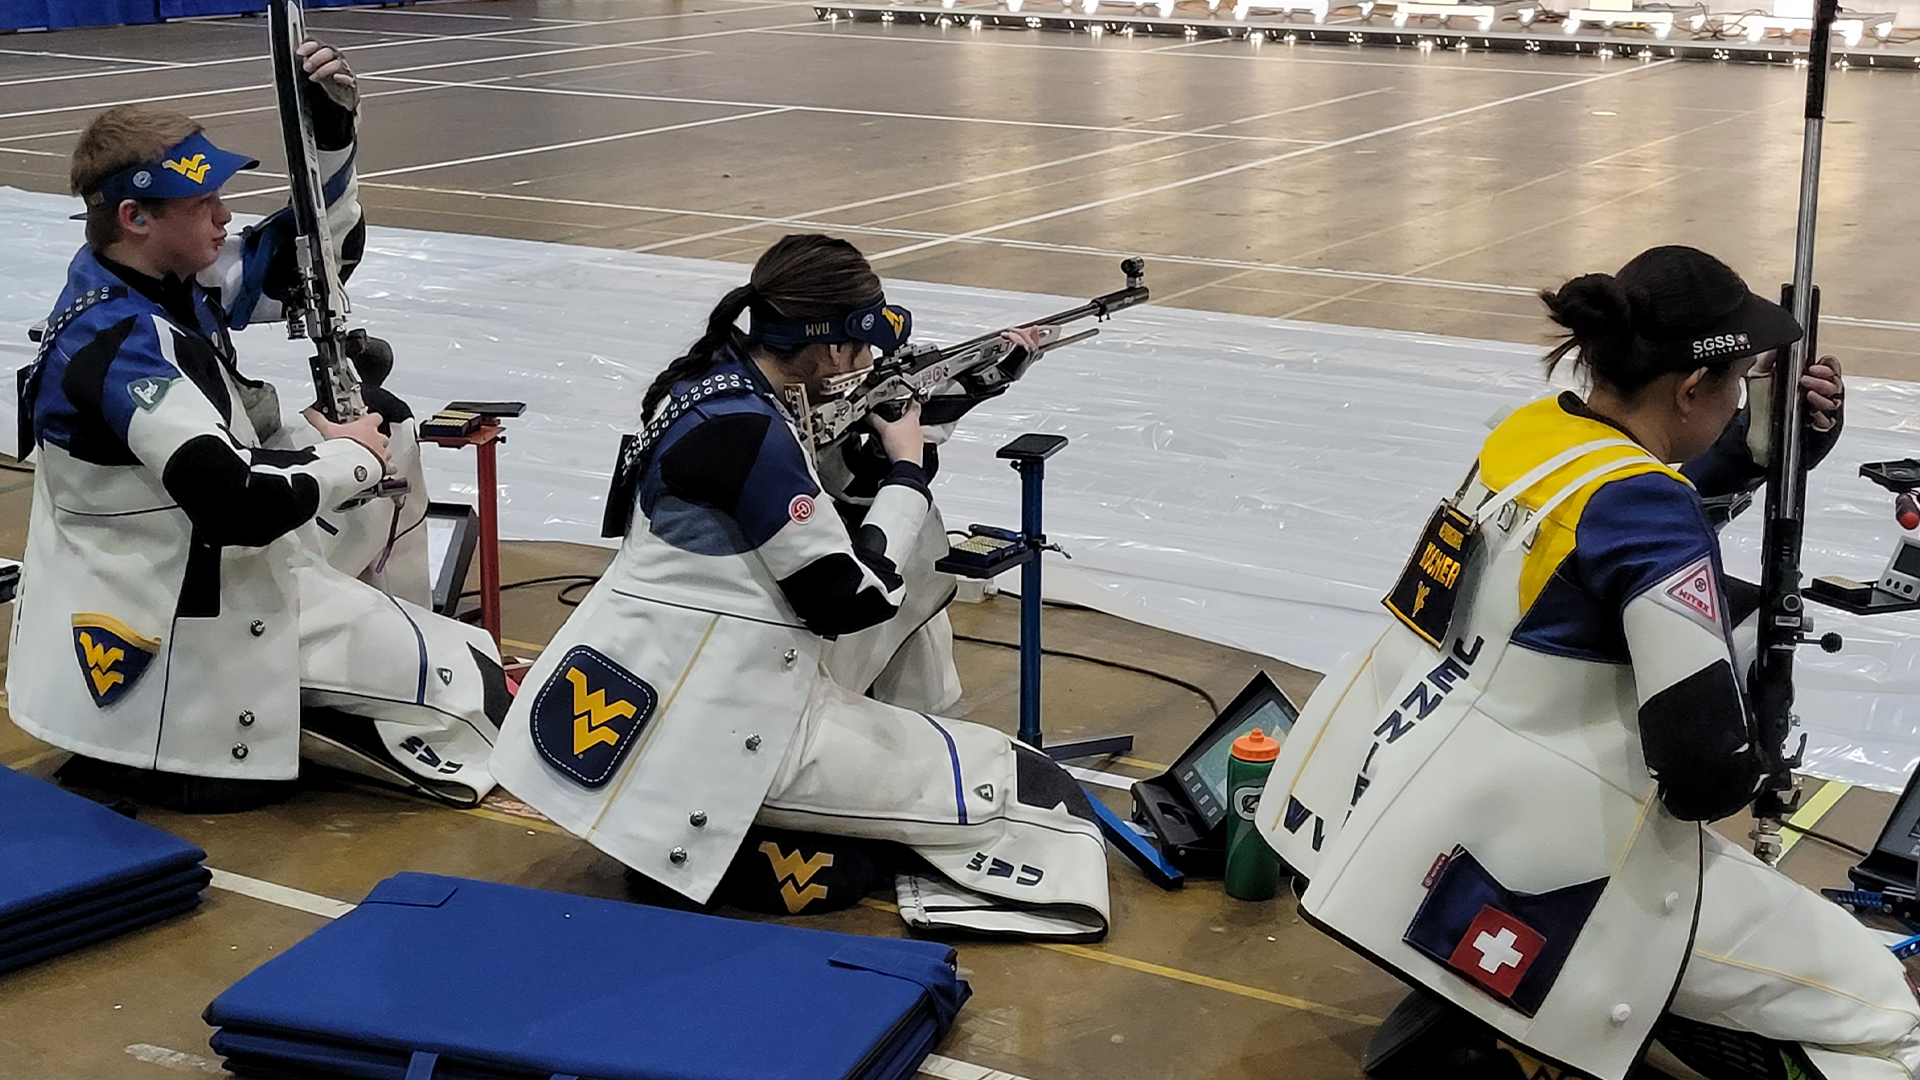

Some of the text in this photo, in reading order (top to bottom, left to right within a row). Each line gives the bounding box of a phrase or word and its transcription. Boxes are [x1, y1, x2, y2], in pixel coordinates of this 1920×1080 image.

[805, 322, 830, 337] WVU
[1693, 334, 1735, 353] SGSS
[966, 851, 1044, 887] WVU
